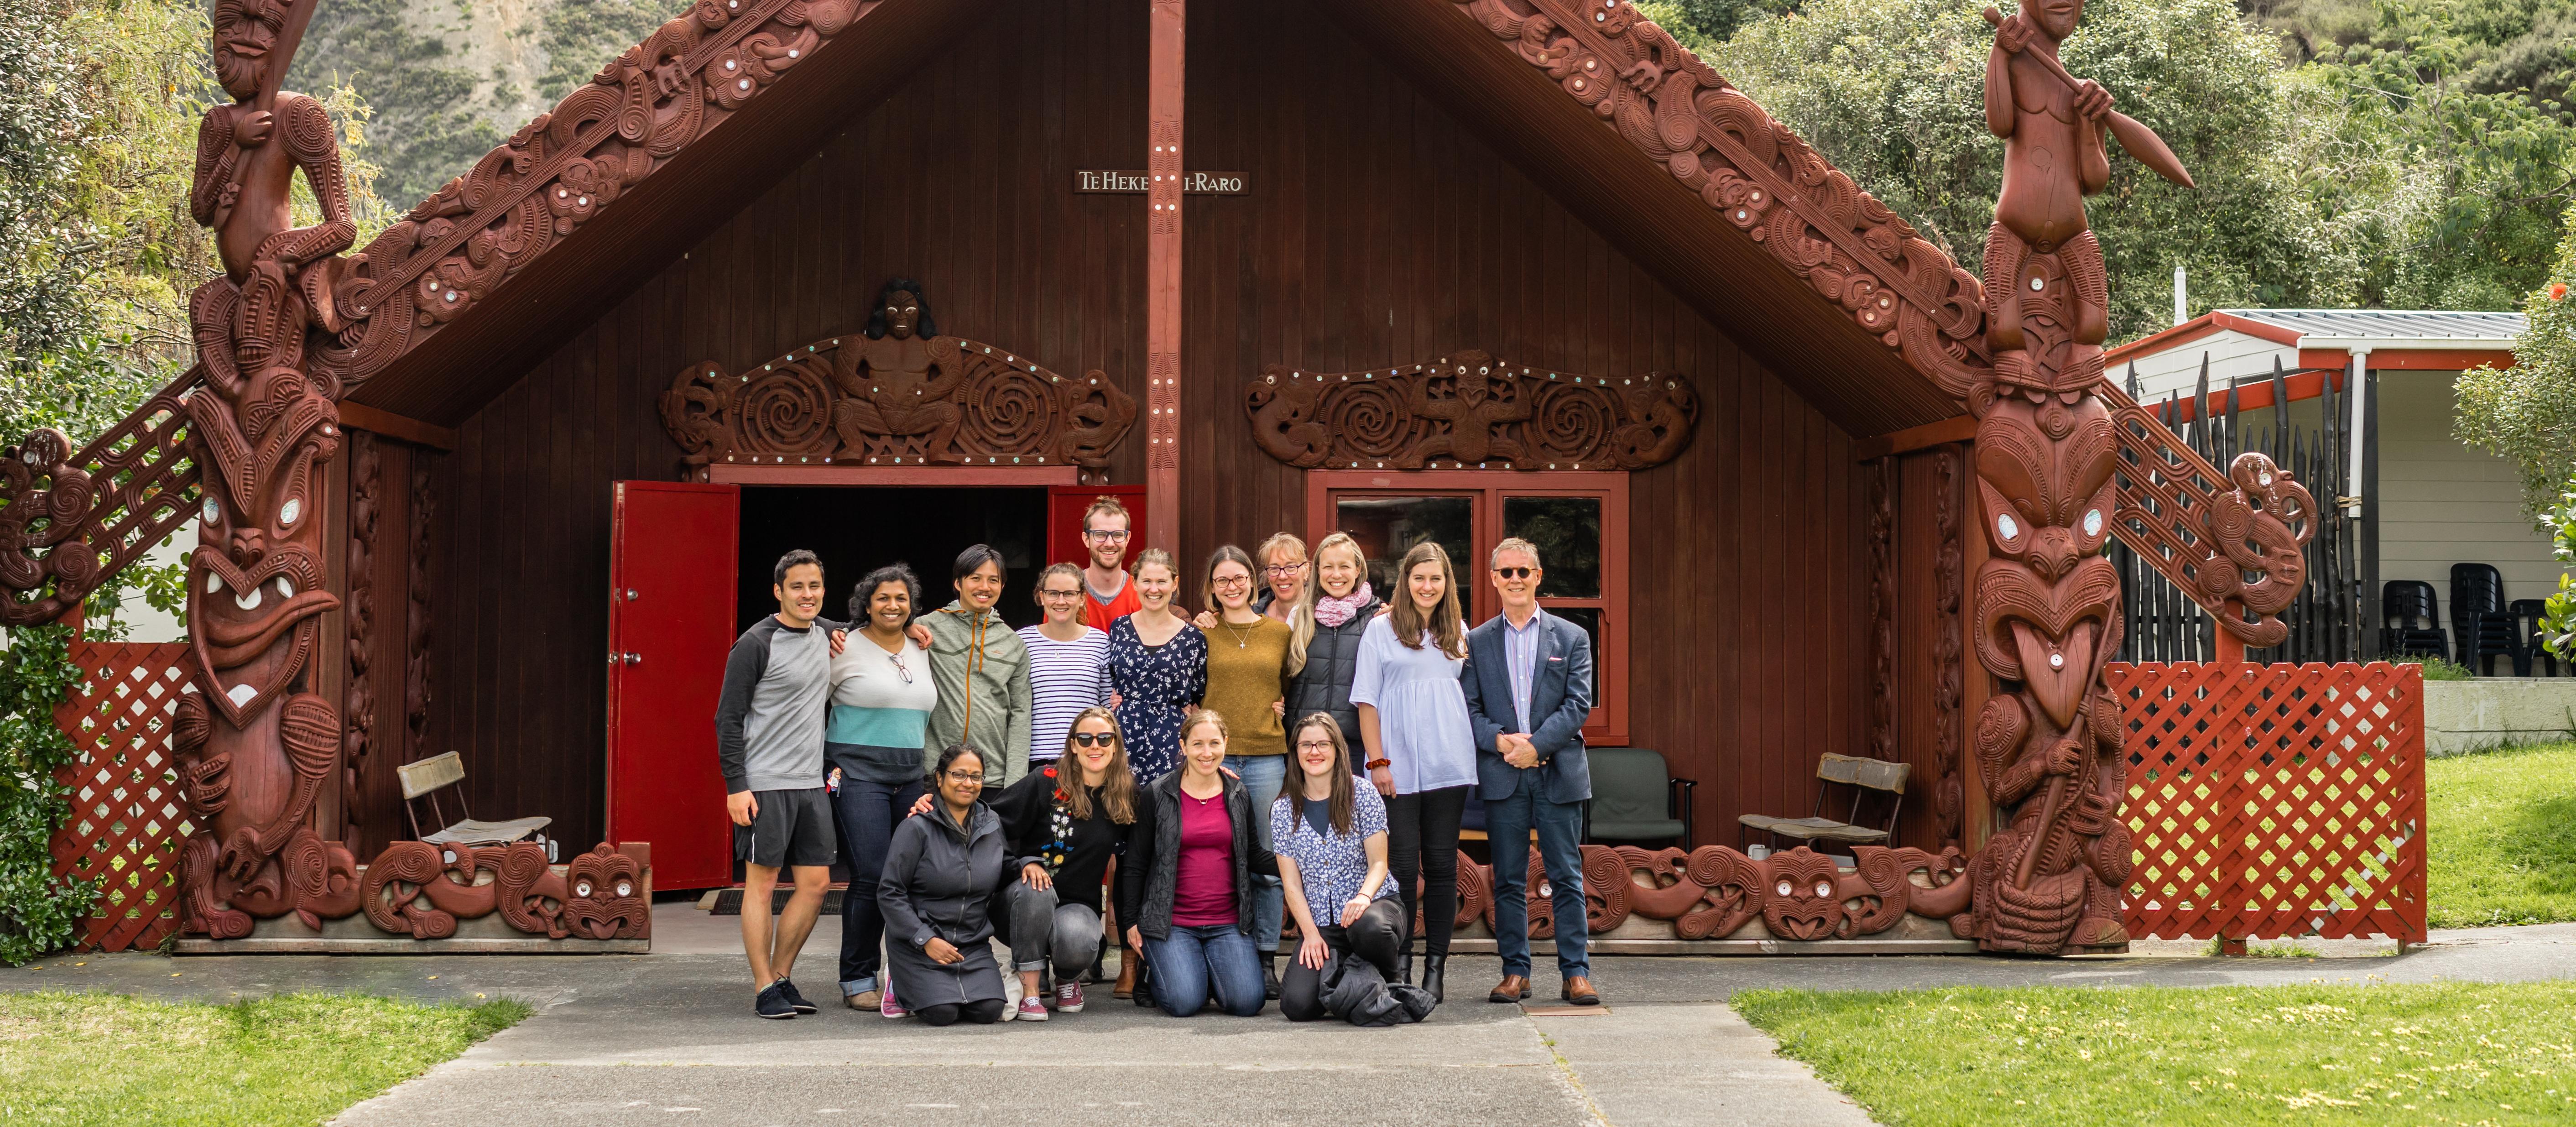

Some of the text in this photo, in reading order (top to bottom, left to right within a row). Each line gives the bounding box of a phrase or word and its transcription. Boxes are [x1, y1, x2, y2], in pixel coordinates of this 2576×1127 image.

[1079, 172, 1241, 191] TE HEKE I-RARO
